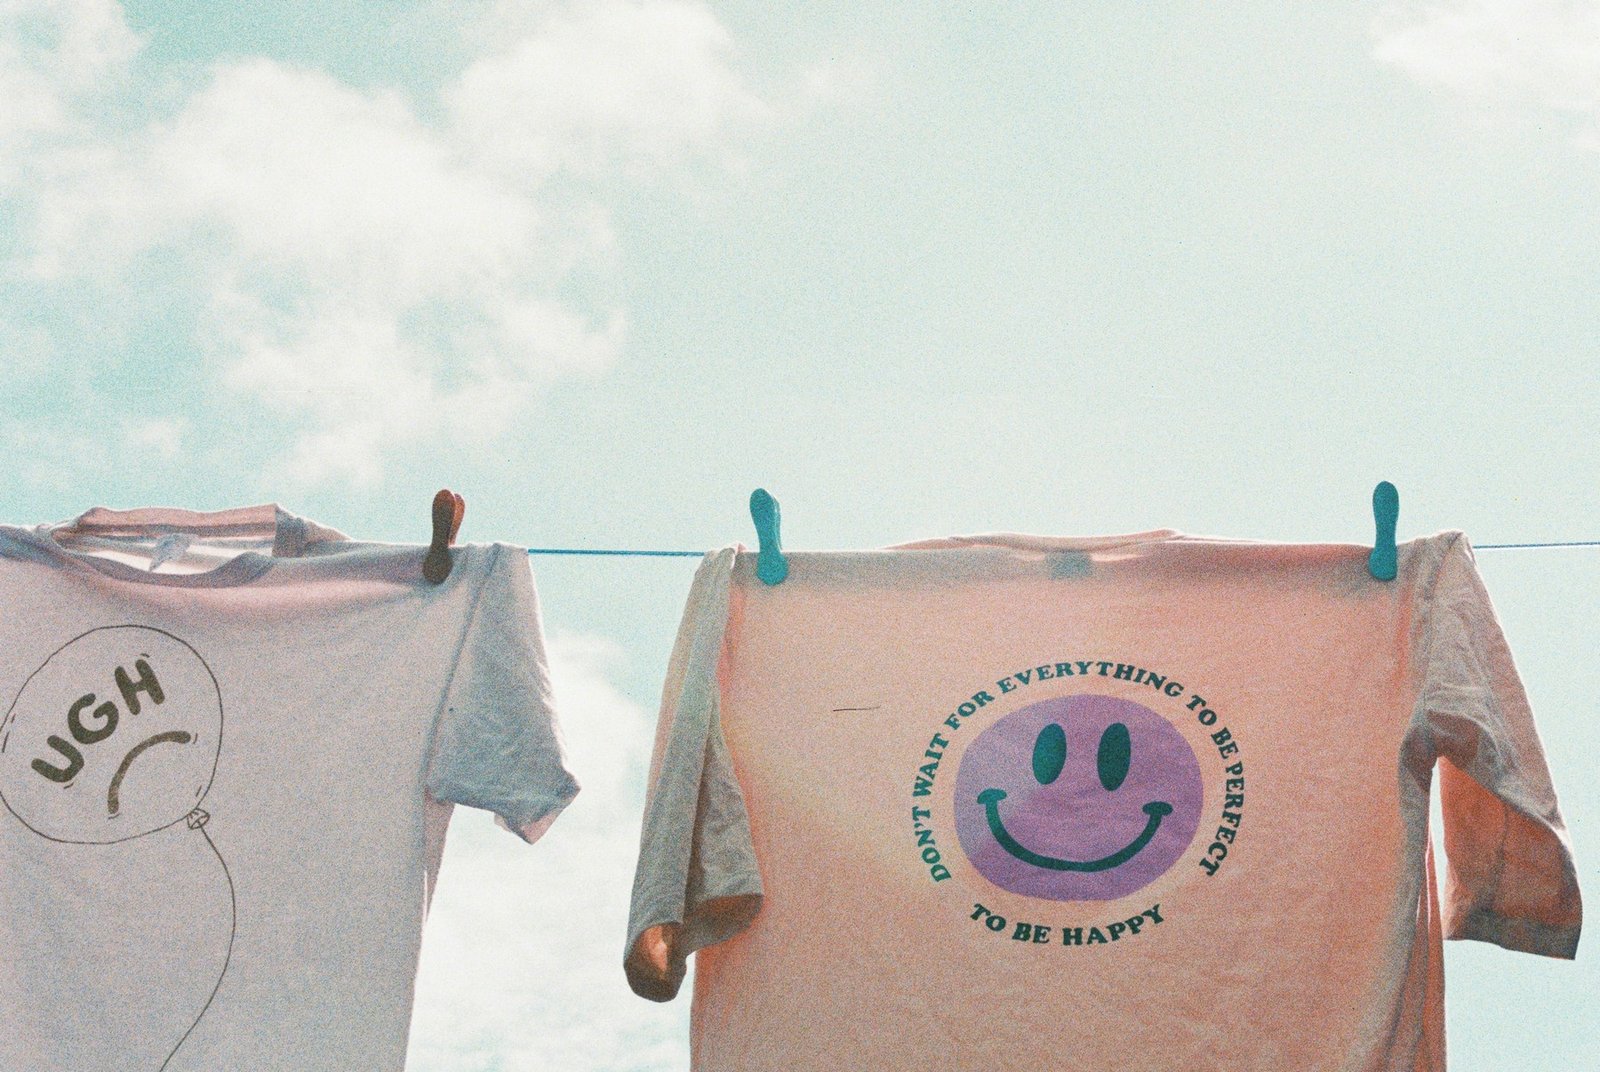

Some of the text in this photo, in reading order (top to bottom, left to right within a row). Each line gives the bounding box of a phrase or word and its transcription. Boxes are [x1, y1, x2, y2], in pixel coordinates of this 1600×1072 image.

[31, 659, 166, 783] UGH
[912, 661, 1244, 882] DON'T WAIT FOR EVERYTHING TO BE PERFECT
[970, 904, 1165, 946] TO BE HAPPY
